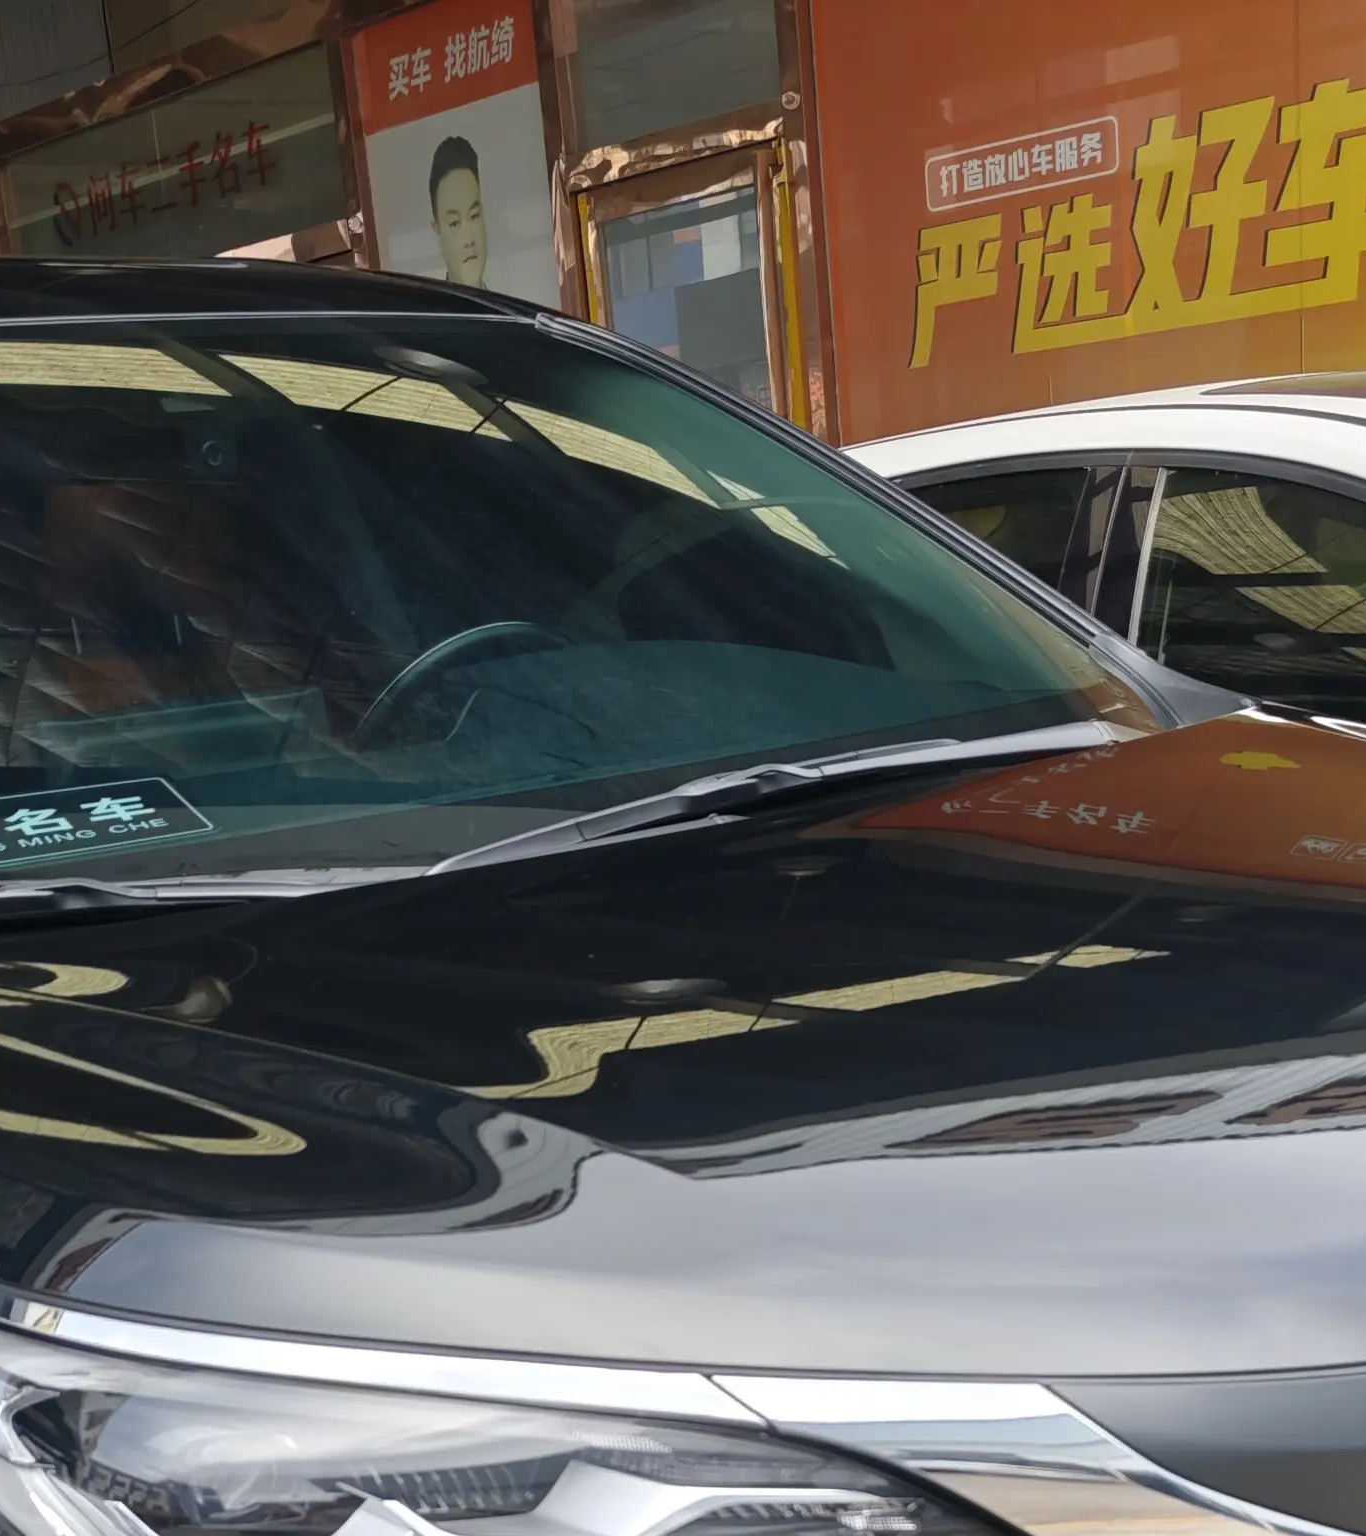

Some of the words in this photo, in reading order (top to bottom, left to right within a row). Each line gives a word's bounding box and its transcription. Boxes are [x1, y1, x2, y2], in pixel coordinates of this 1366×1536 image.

[388, 47, 431, 101] 买车
[444, 15, 514, 84] 找航绮
[939, 132, 1103, 198] 打造放心车服务
[16, 828, 98, 849] MING
[107, 817, 170, 835] CHE
